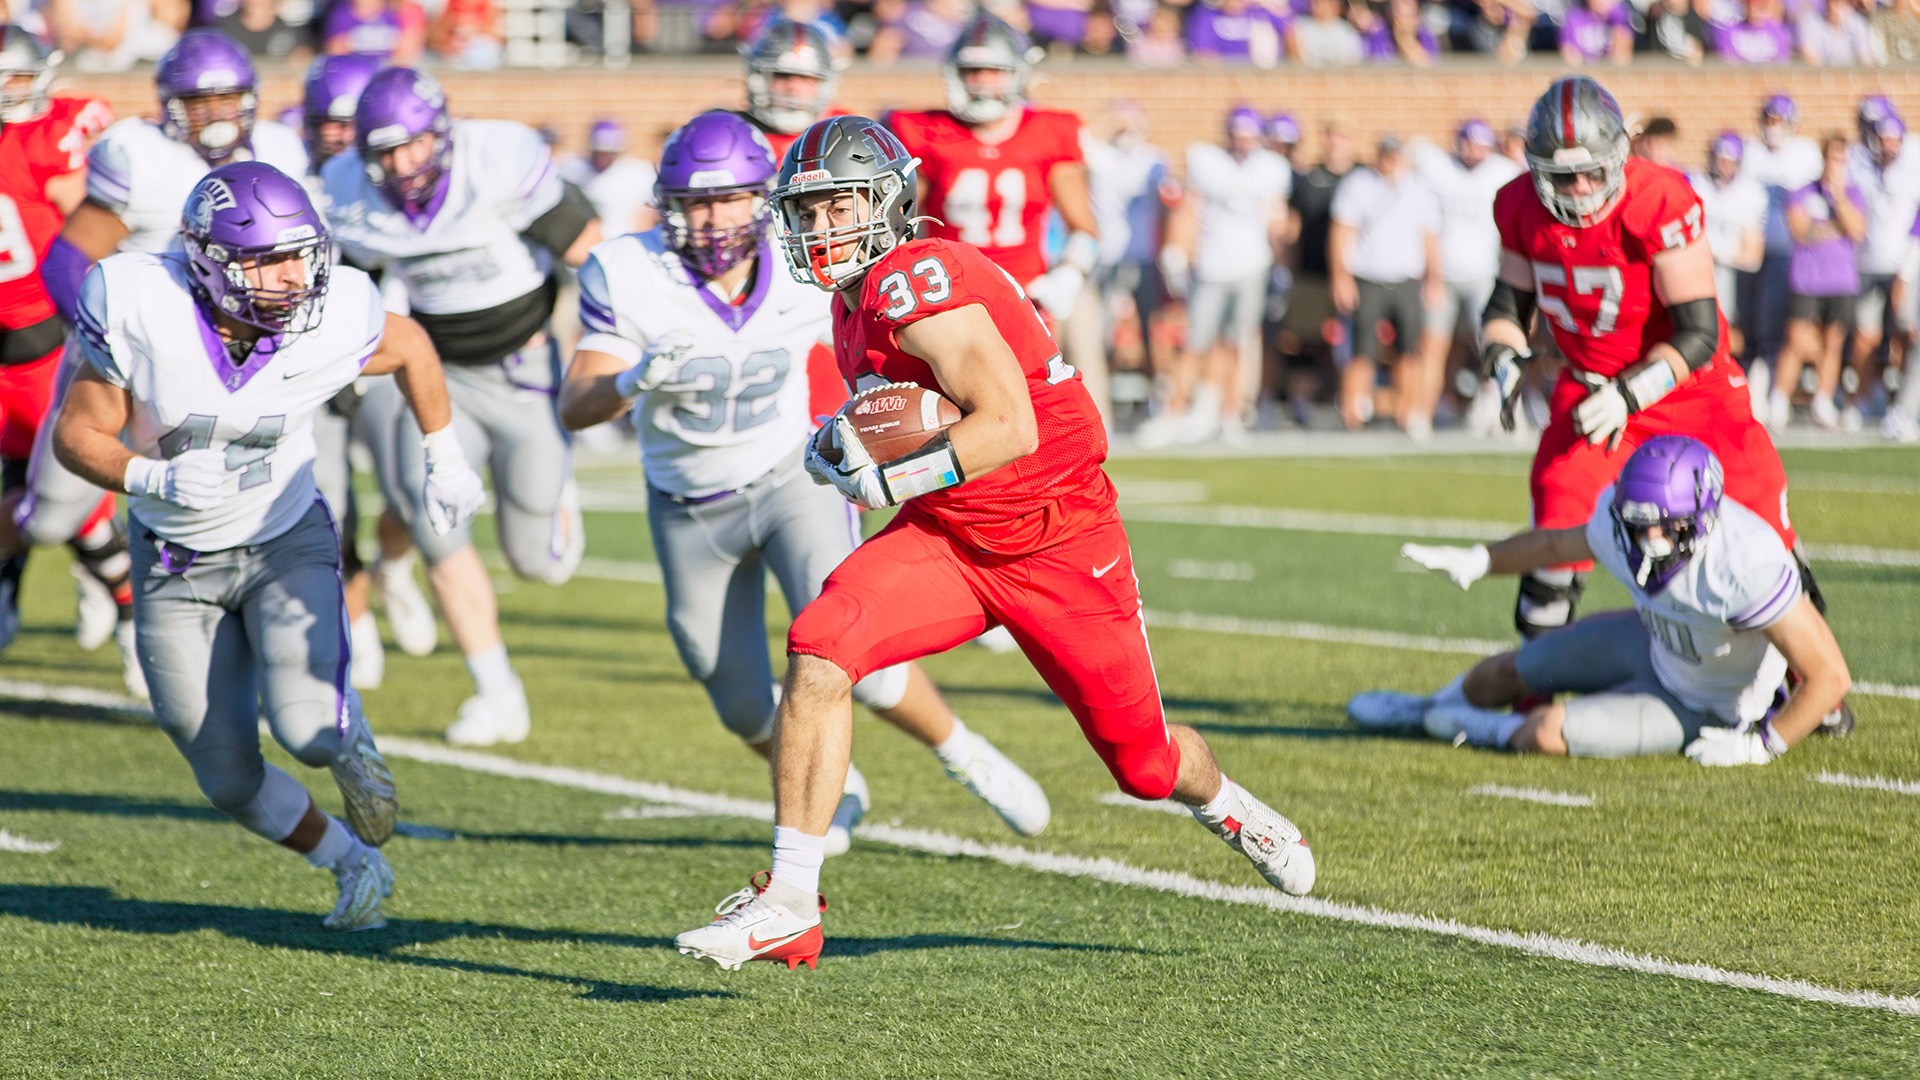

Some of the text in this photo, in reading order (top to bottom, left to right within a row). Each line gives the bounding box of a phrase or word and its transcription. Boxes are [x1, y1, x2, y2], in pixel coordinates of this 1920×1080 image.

[791, 171, 825, 185] Riddell
[942, 168, 1027, 248] 41
[1660, 203, 1702, 250] 57
[877, 255, 951, 321] 33
[1532, 261, 1624, 338] 57
[671, 347, 791, 433] 32
